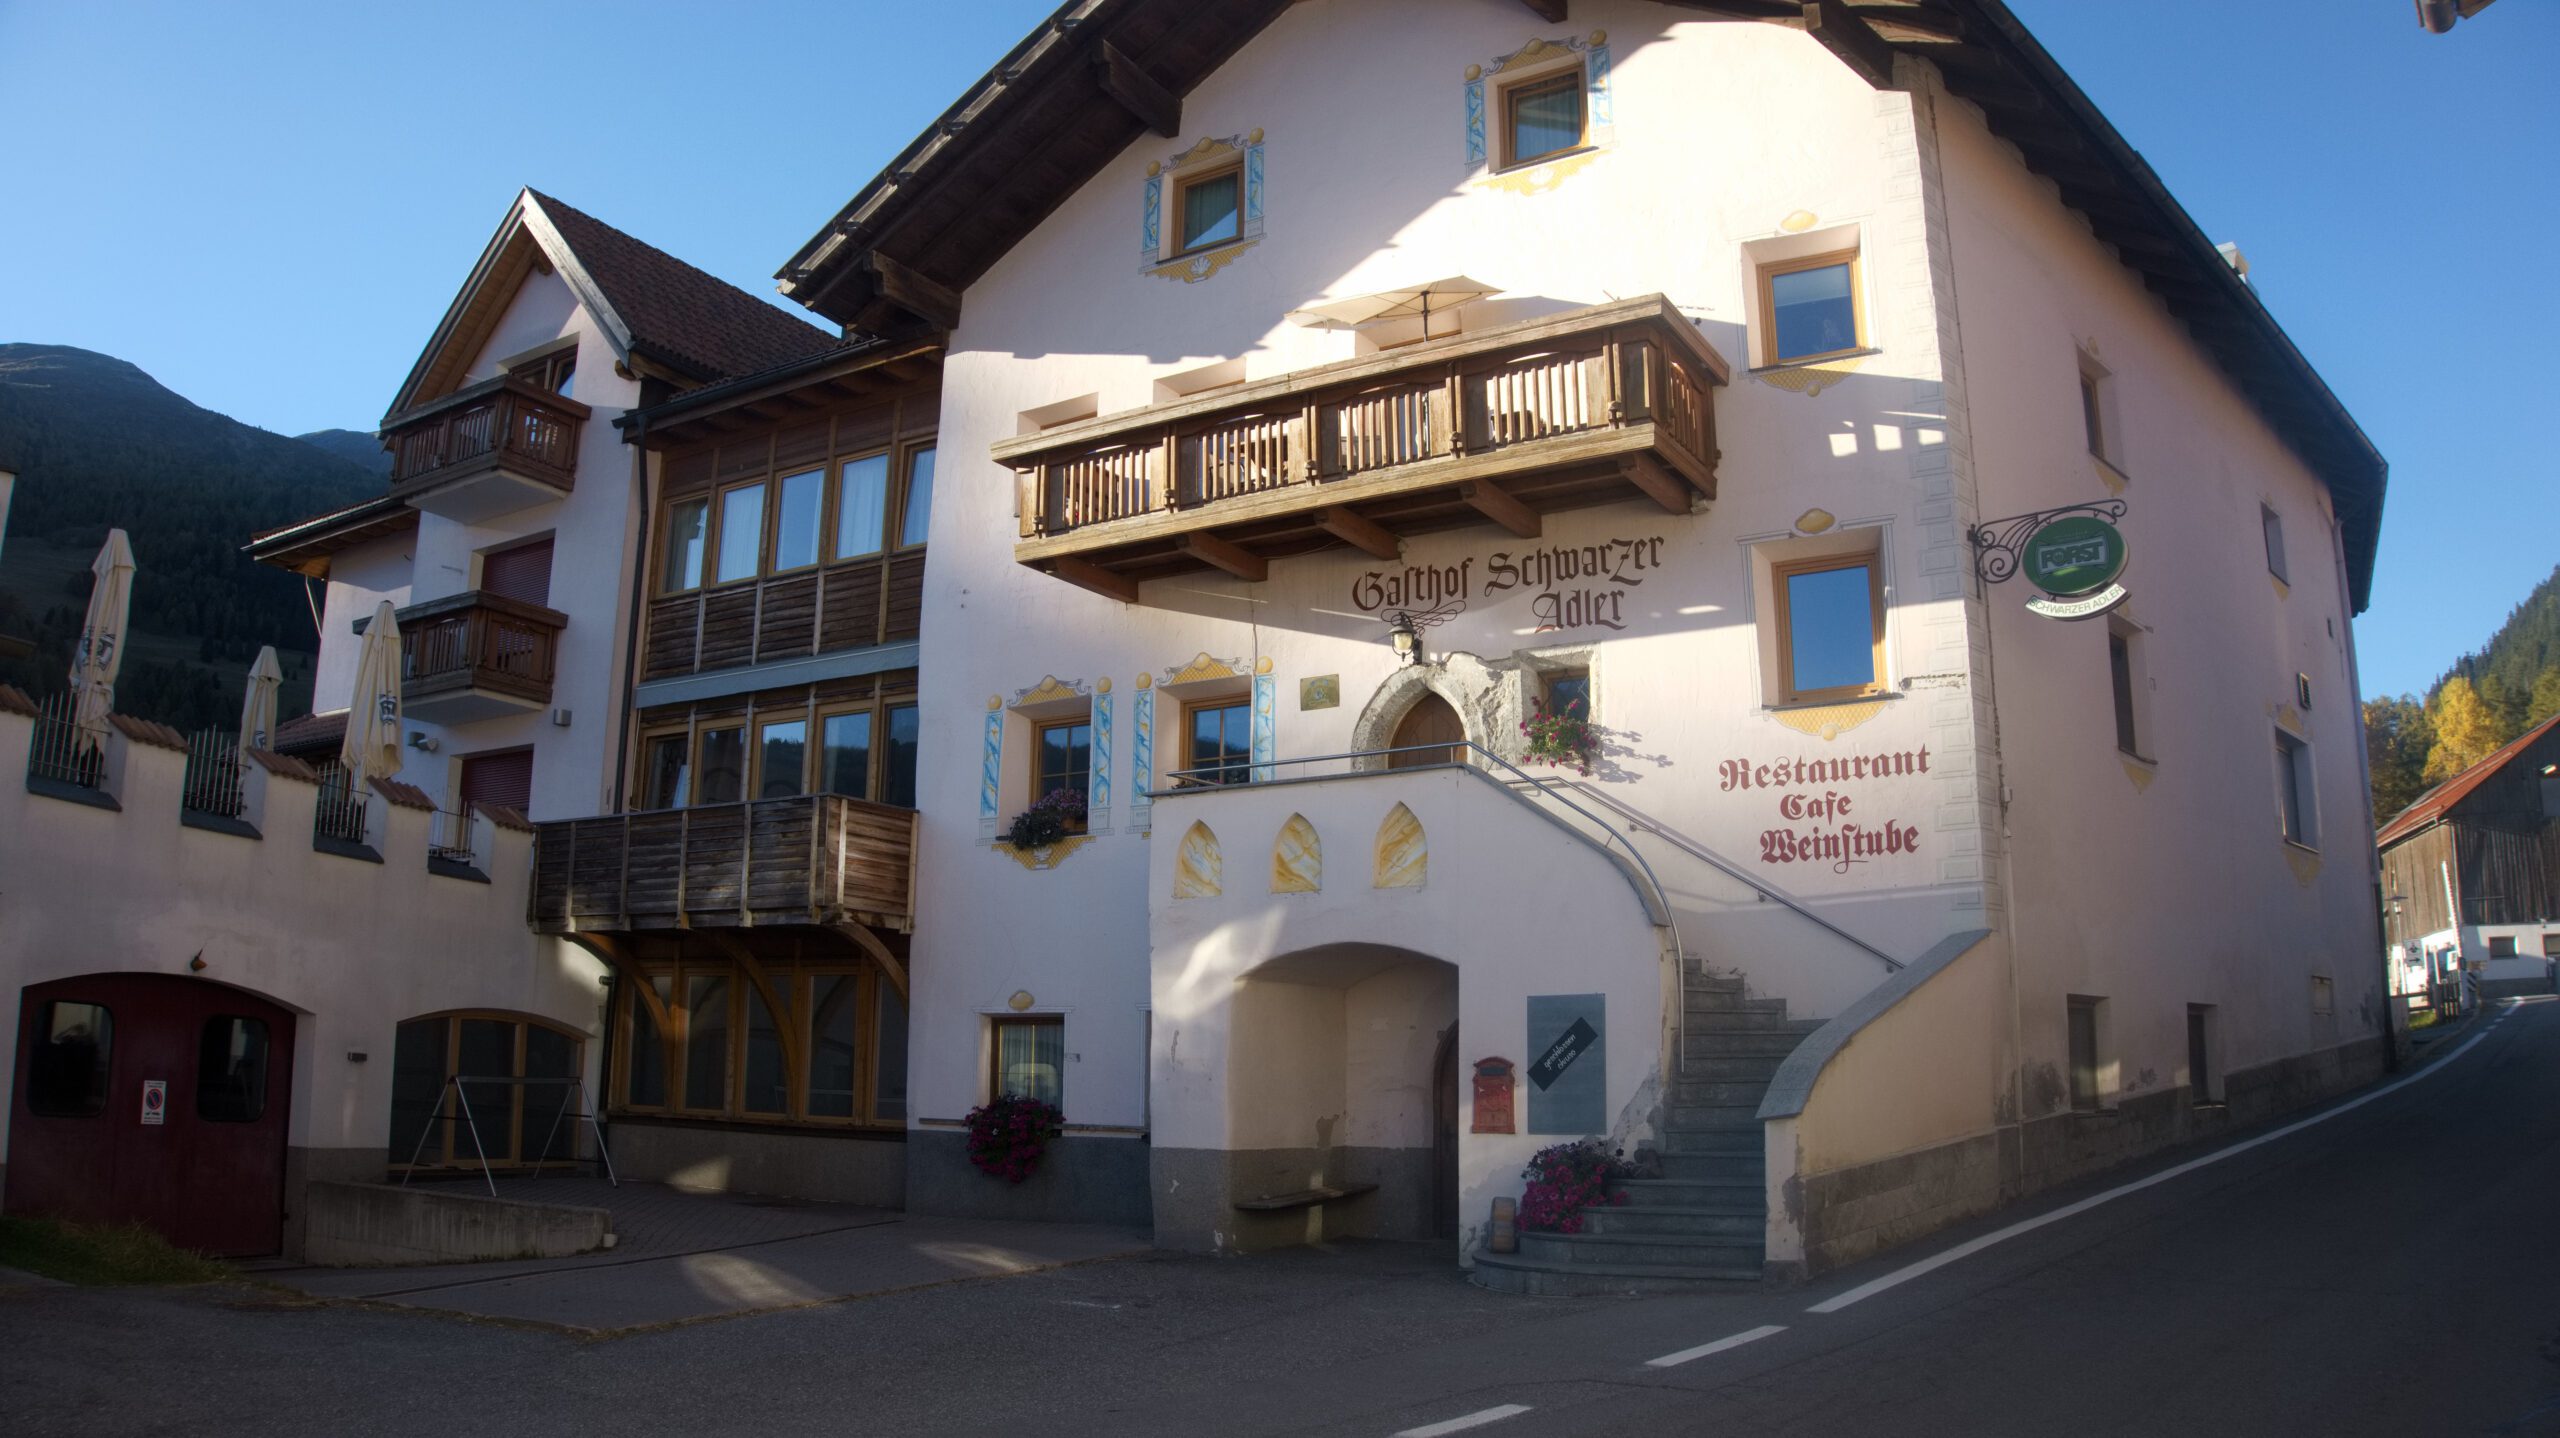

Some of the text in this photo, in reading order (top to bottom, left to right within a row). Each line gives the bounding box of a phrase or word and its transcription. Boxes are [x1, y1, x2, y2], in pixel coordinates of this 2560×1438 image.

[2041, 541, 2104, 569] FORST
[1532, 588, 1628, 634] Adler
[2029, 586, 2123, 614] SCHWARZER ADLER
[1719, 743, 1932, 792] Restaurant
[1780, 790, 1852, 826] Cafe
